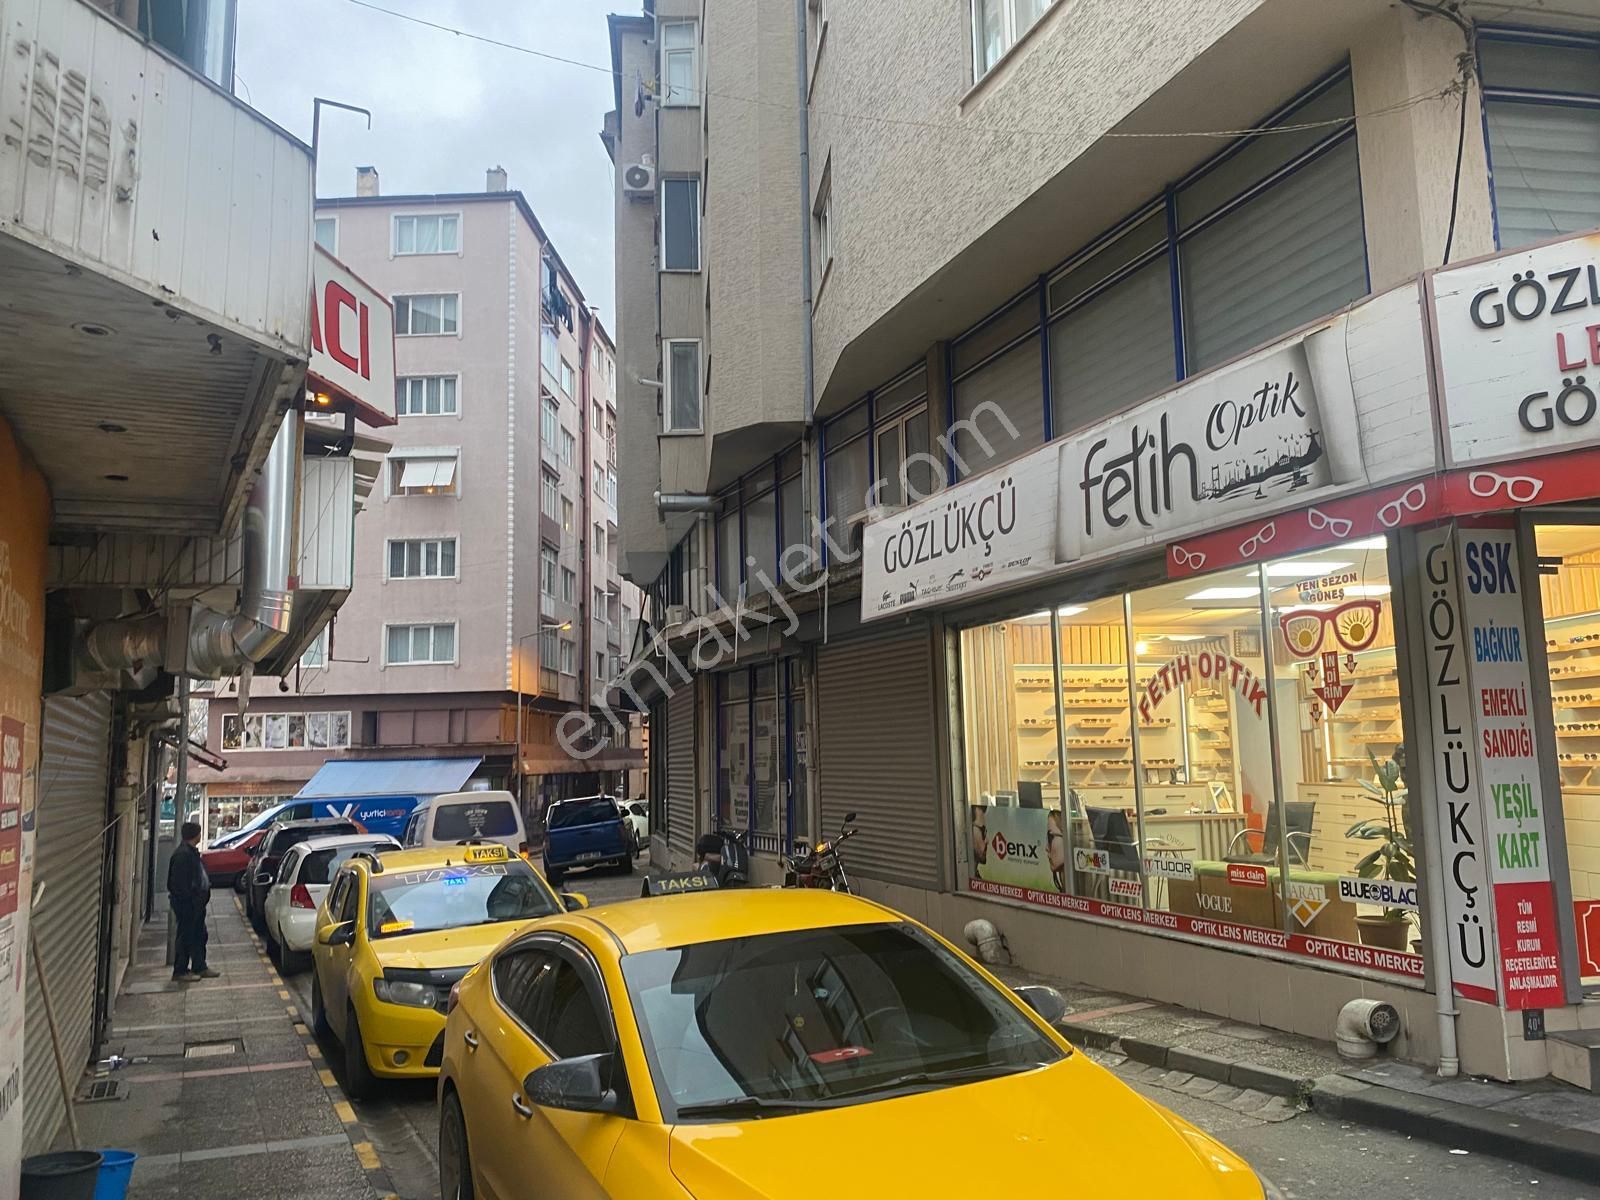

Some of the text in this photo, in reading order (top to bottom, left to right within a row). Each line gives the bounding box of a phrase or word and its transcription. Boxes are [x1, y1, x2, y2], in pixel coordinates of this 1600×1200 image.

[1205, 371, 1305, 452] Optik
[1518, 375, 1600, 433] GÖ
[884, 477, 1016, 574] GÖZLÜKÇÜ
[1465, 541, 1516, 594] SSK
[1322, 572, 1358, 588] SEZON
[878, 599, 896, 611] LACOSTE
[1310, 588, 1345, 603] GÜNEŞ
[1473, 619, 1523, 663] BAĞKUR
[1481, 680, 1528, 717] EMEKLİ
[1483, 722, 1534, 758] SANDIĞI
[1426, 543, 1486, 968] GÖZLÜKÇÜ
[1490, 774, 1539, 828] YEŞİL
[1496, 831, 1540, 869] KART
[395, 864, 508, 885] TAXI
[1154, 859, 1192, 874] TUDOR
[1231, 869, 1265, 881] miss claire
[444, 877, 466, 885] TAXI
[986, 883, 1000, 894] LENS
[1341, 880, 1371, 899] BLUE
[1045, 894, 1061, 906] LENS
[1196, 892, 1233, 913] VOGUE
[1517, 898, 1533, 915] TÜM
[1123, 909, 1142, 922] LENS
[1218, 925, 1241, 941] LENS
[1516, 917, 1537, 934] RESMİ
[1517, 938, 1541, 953] KURUM
[1342, 946, 1372, 965] LENS
[1505, 954, 1557, 972] REÇETELERİYLE
[1509, 974, 1558, 993] ANLAŞMALIDIR
